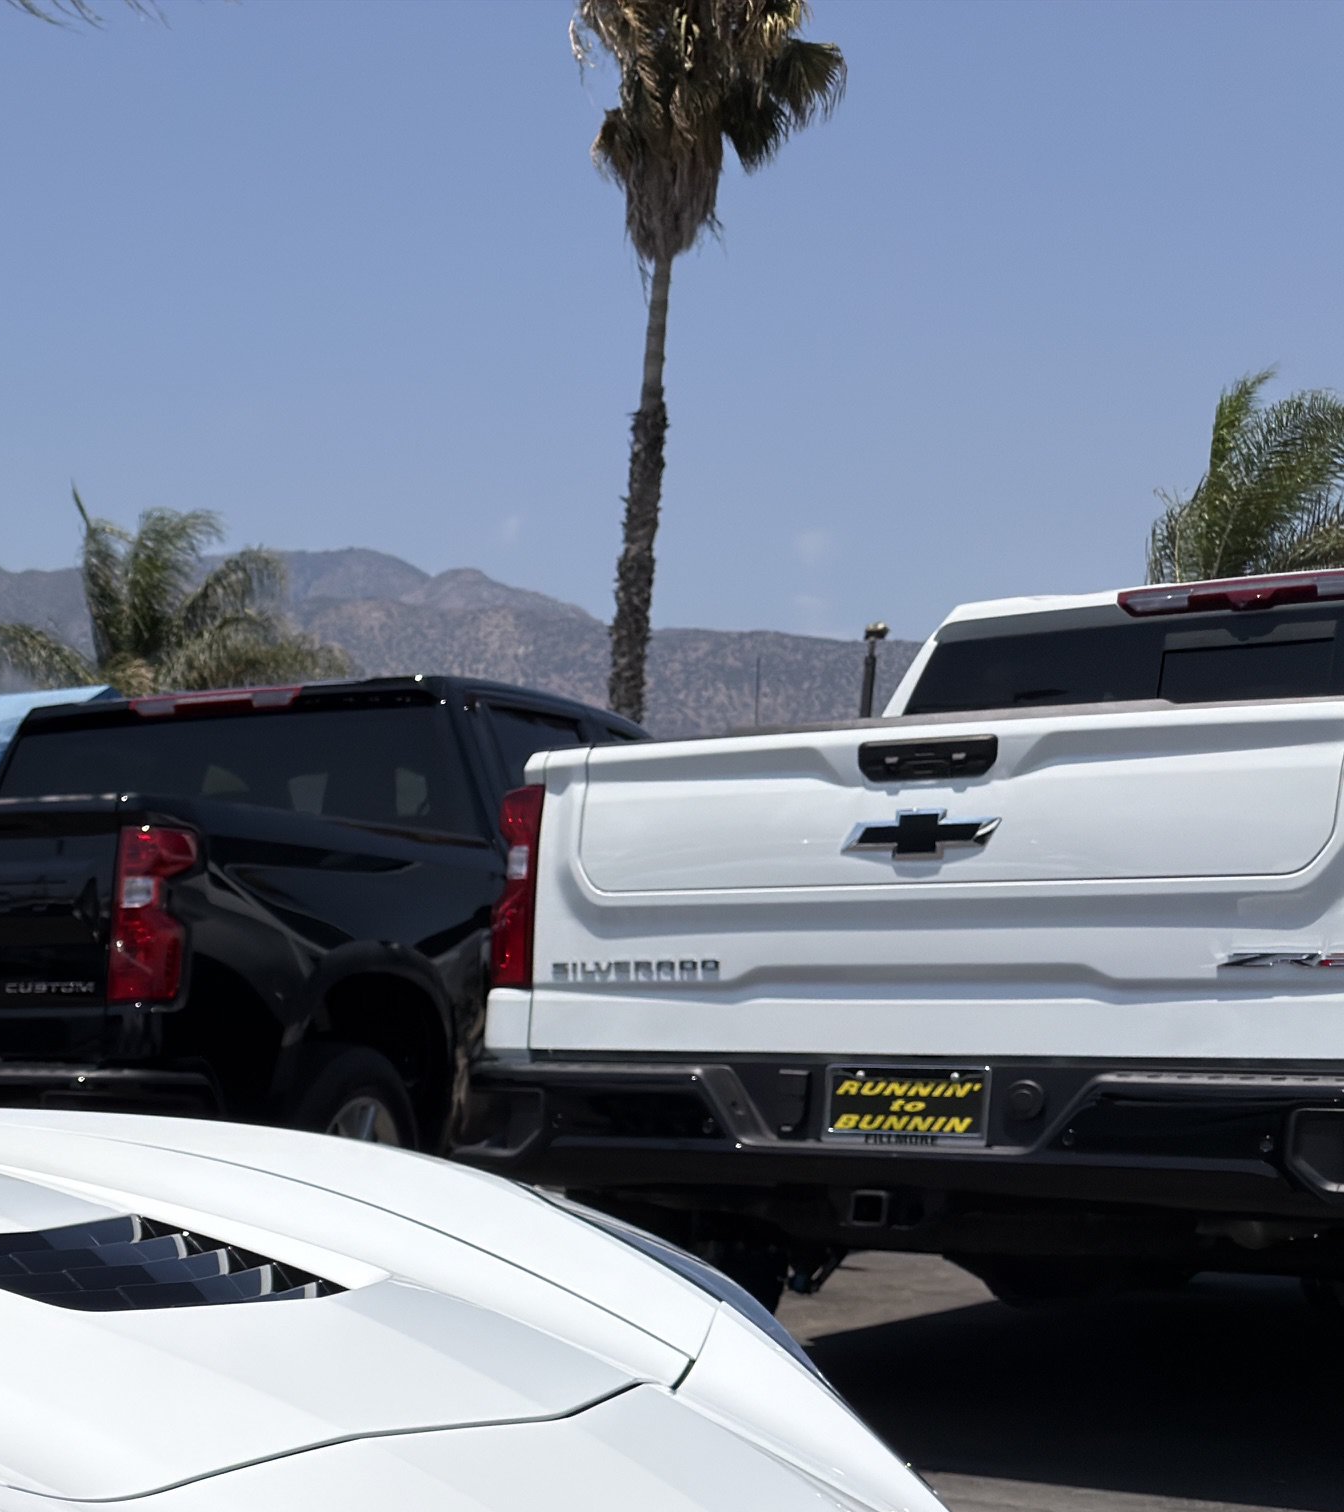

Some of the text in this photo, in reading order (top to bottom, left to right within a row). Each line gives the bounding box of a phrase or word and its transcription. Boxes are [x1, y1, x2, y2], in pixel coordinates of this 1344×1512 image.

[551, 959, 721, 977] SILVERADO
[5, 981, 95, 993] CUSTOM
[836, 1080, 983, 1098] RUNNIN'
[889, 1099, 927, 1112] to
[832, 1113, 973, 1133] BUNNIN
